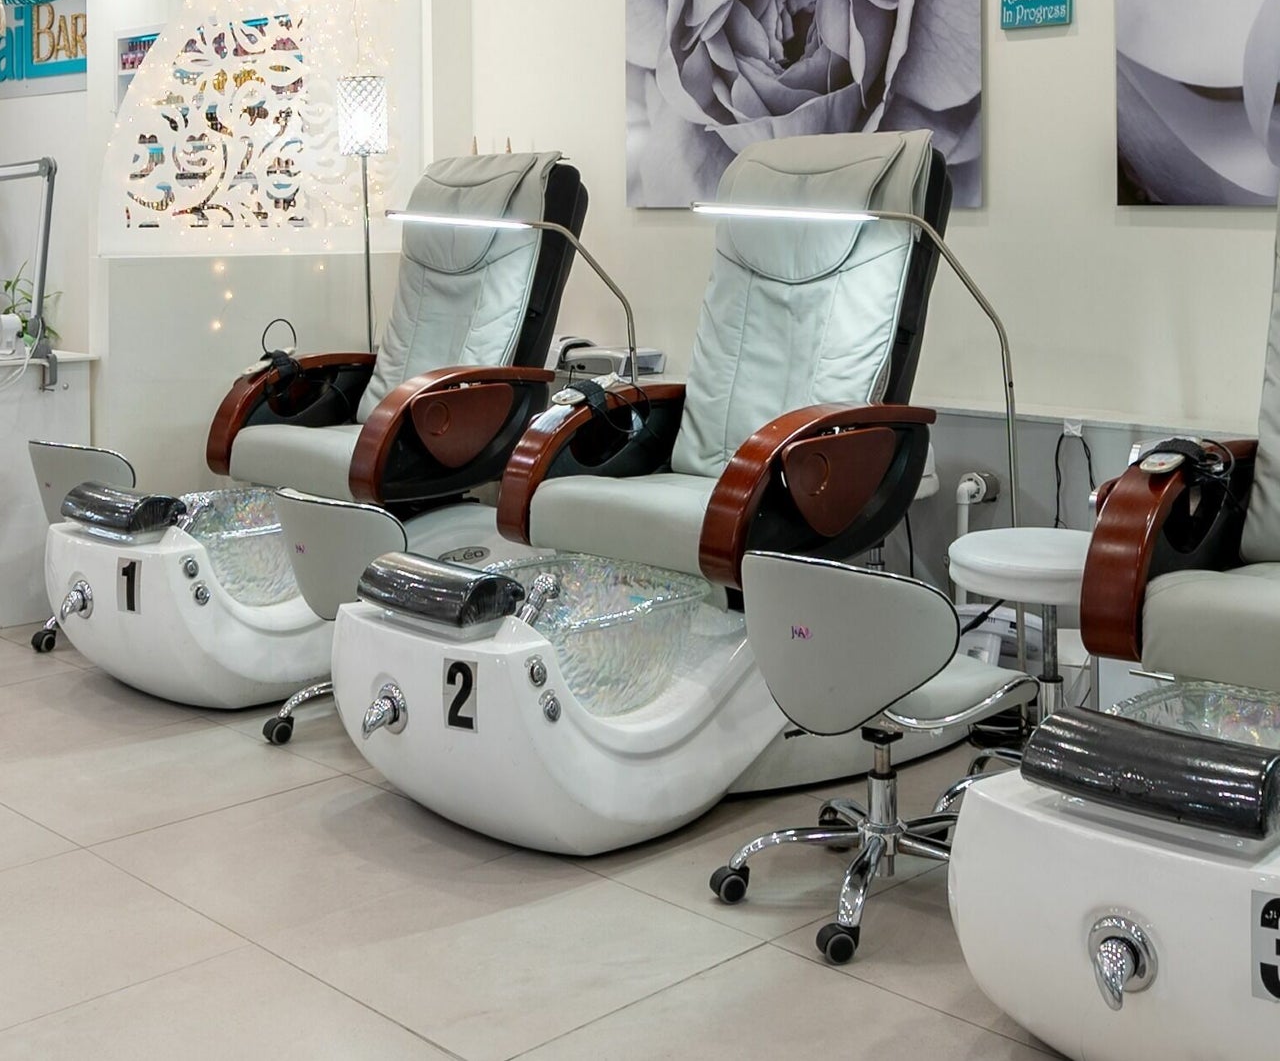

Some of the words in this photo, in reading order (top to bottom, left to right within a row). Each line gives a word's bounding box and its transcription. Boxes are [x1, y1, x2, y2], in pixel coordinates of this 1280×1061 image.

[1003, 6, 1013, 23] In
[1015, 4, 1066, 25] Progress
[122, 561, 136, 611] 1
[447, 661, 474, 730] 2
